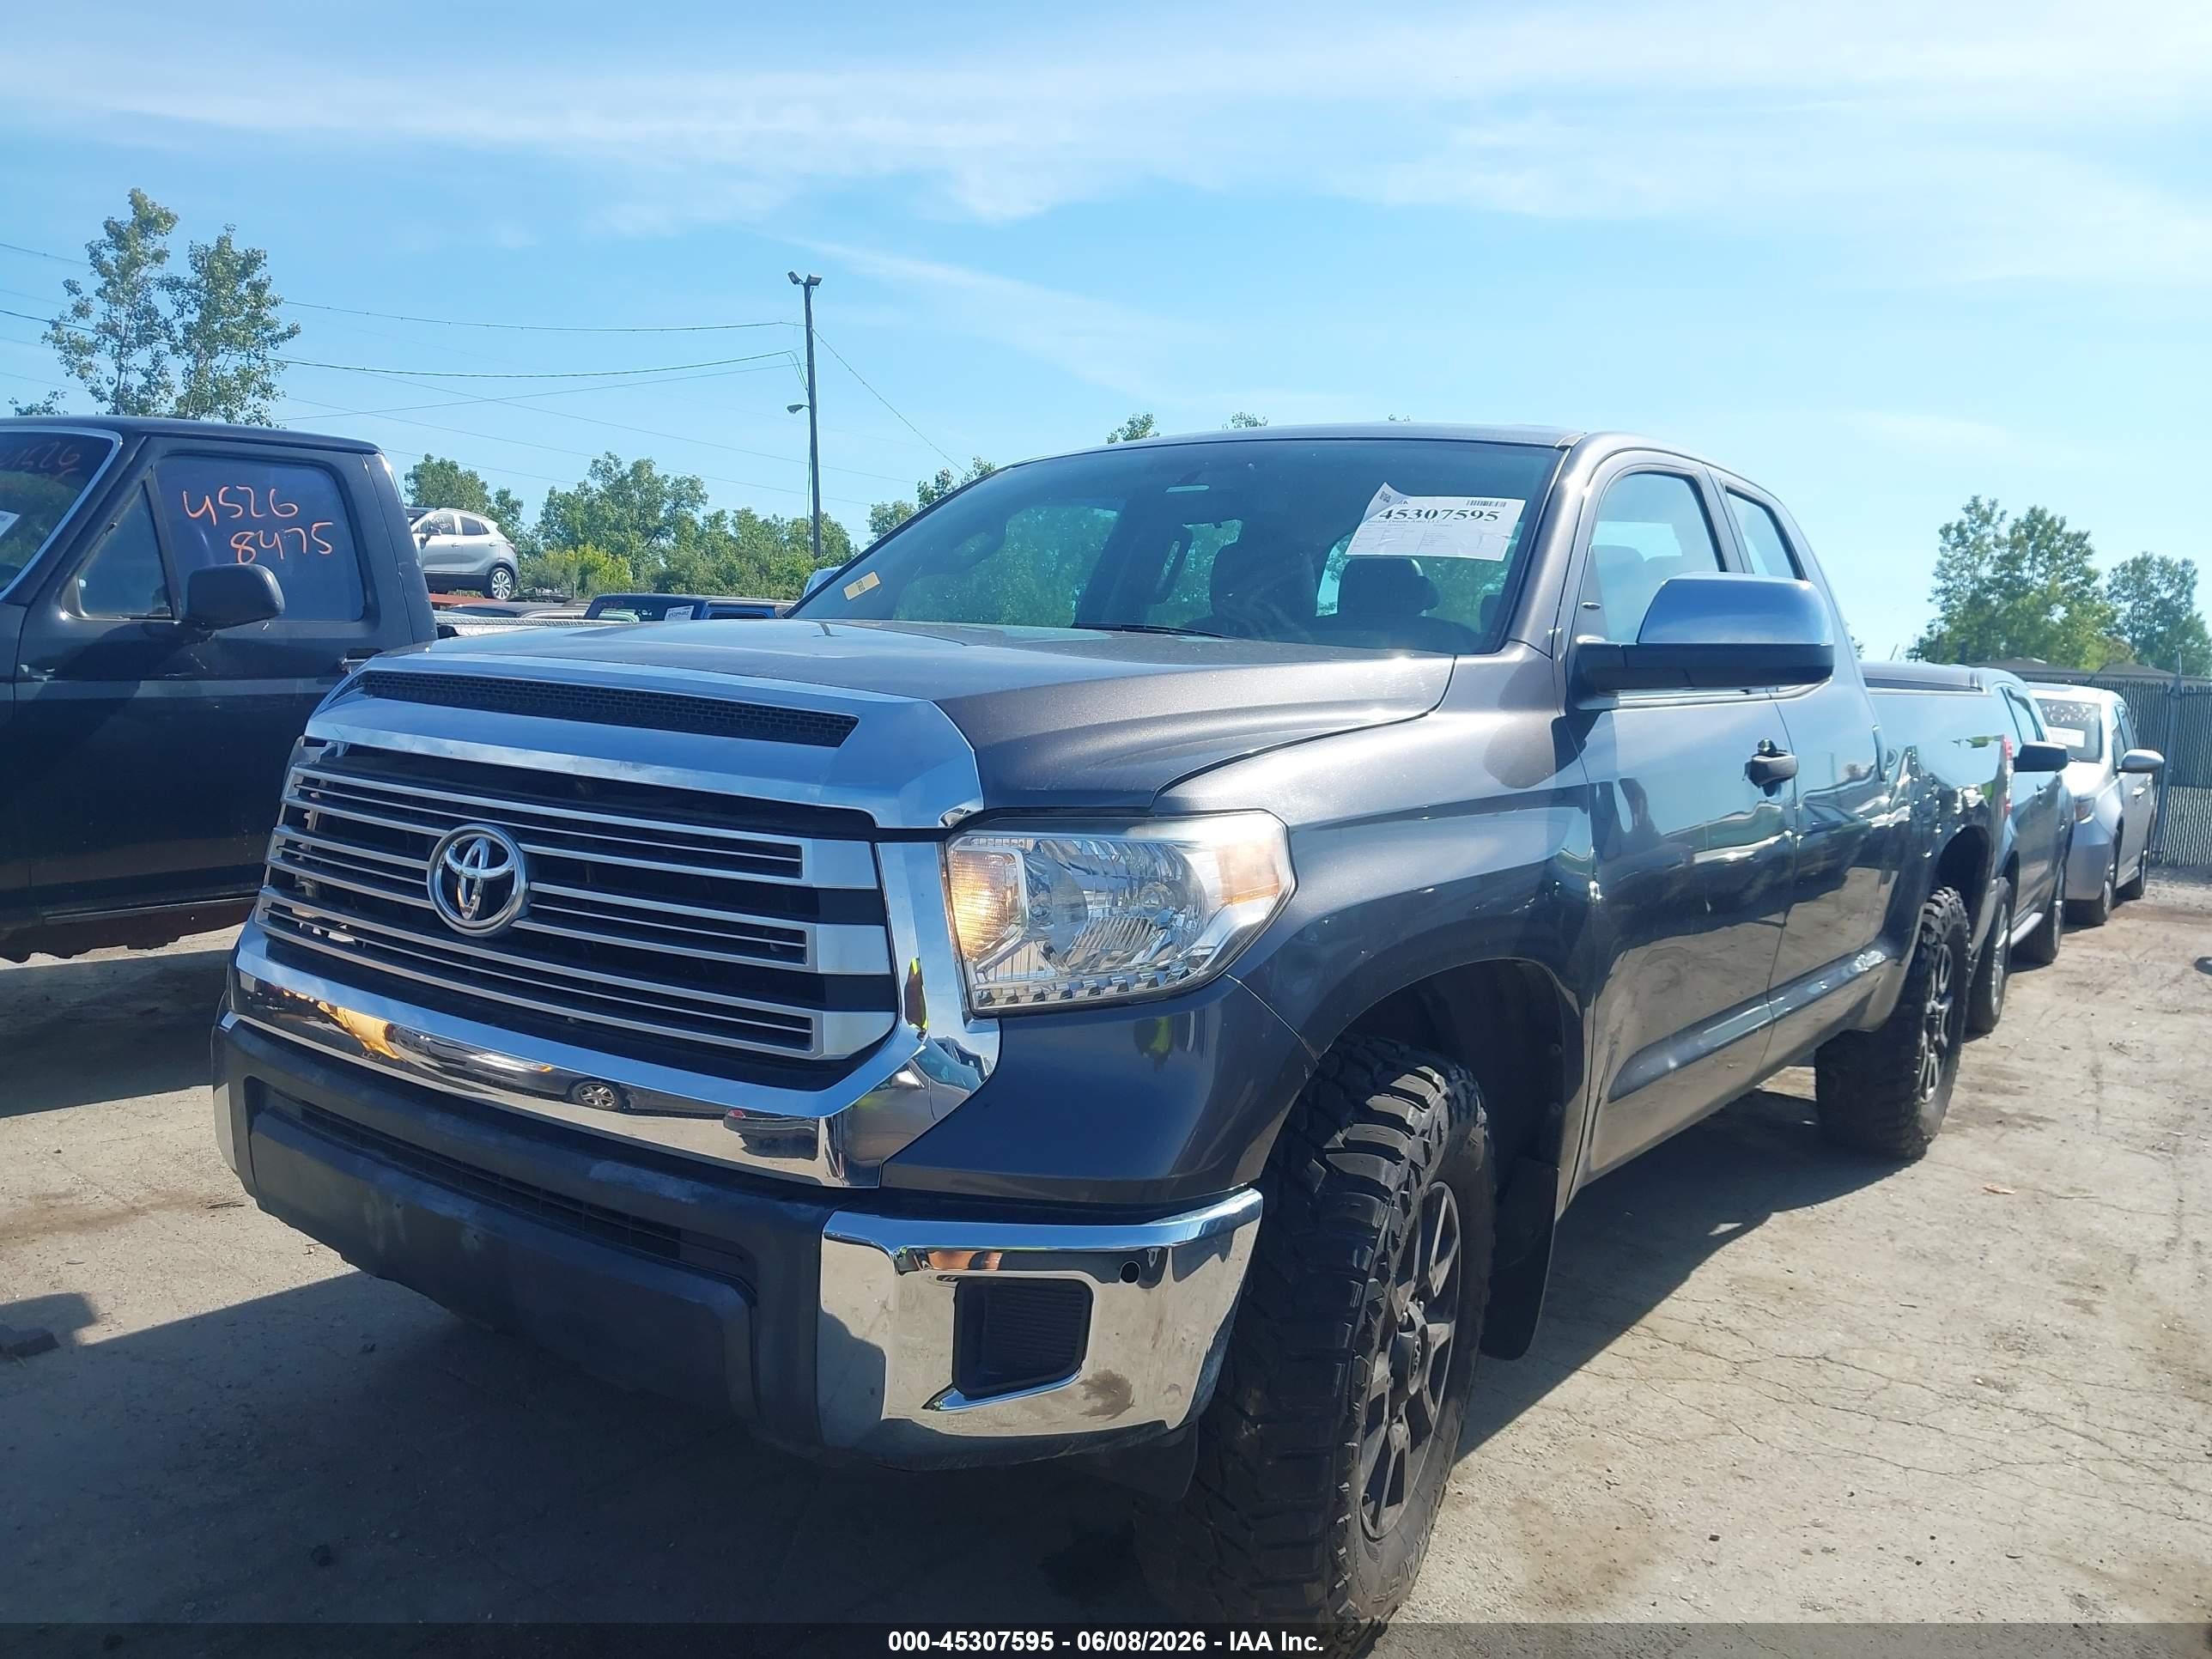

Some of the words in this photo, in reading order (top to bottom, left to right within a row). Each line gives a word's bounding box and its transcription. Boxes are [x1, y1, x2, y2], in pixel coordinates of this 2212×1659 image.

[182, 486, 299, 526] 4526
[1379, 508, 1501, 522] 45307595
[230, 522, 334, 564] 8475
